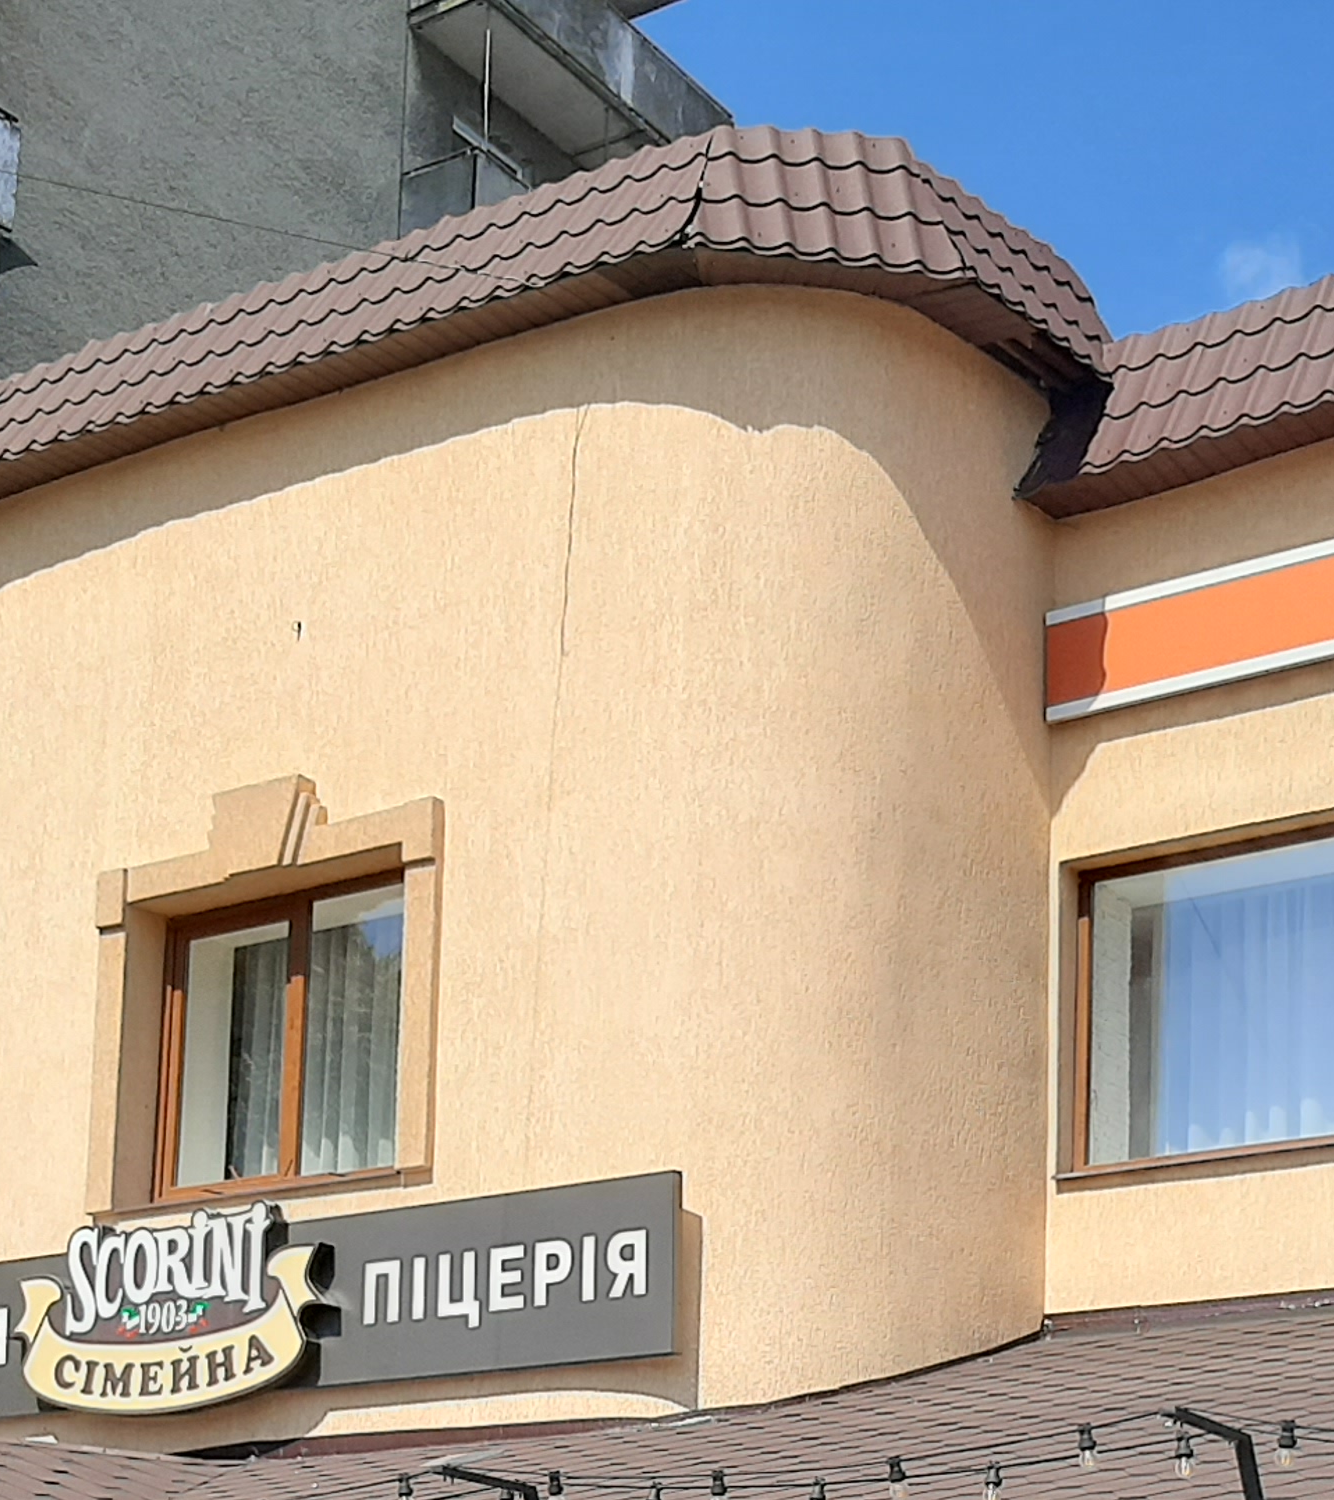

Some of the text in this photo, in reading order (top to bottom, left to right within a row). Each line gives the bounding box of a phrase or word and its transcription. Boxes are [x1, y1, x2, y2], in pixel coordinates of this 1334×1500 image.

[362, 1229, 650, 1329] ПІЦЕРІЯ
[138, 1299, 188, 1334] 1903
[54, 1334, 275, 1398] СІМЕЙНА
